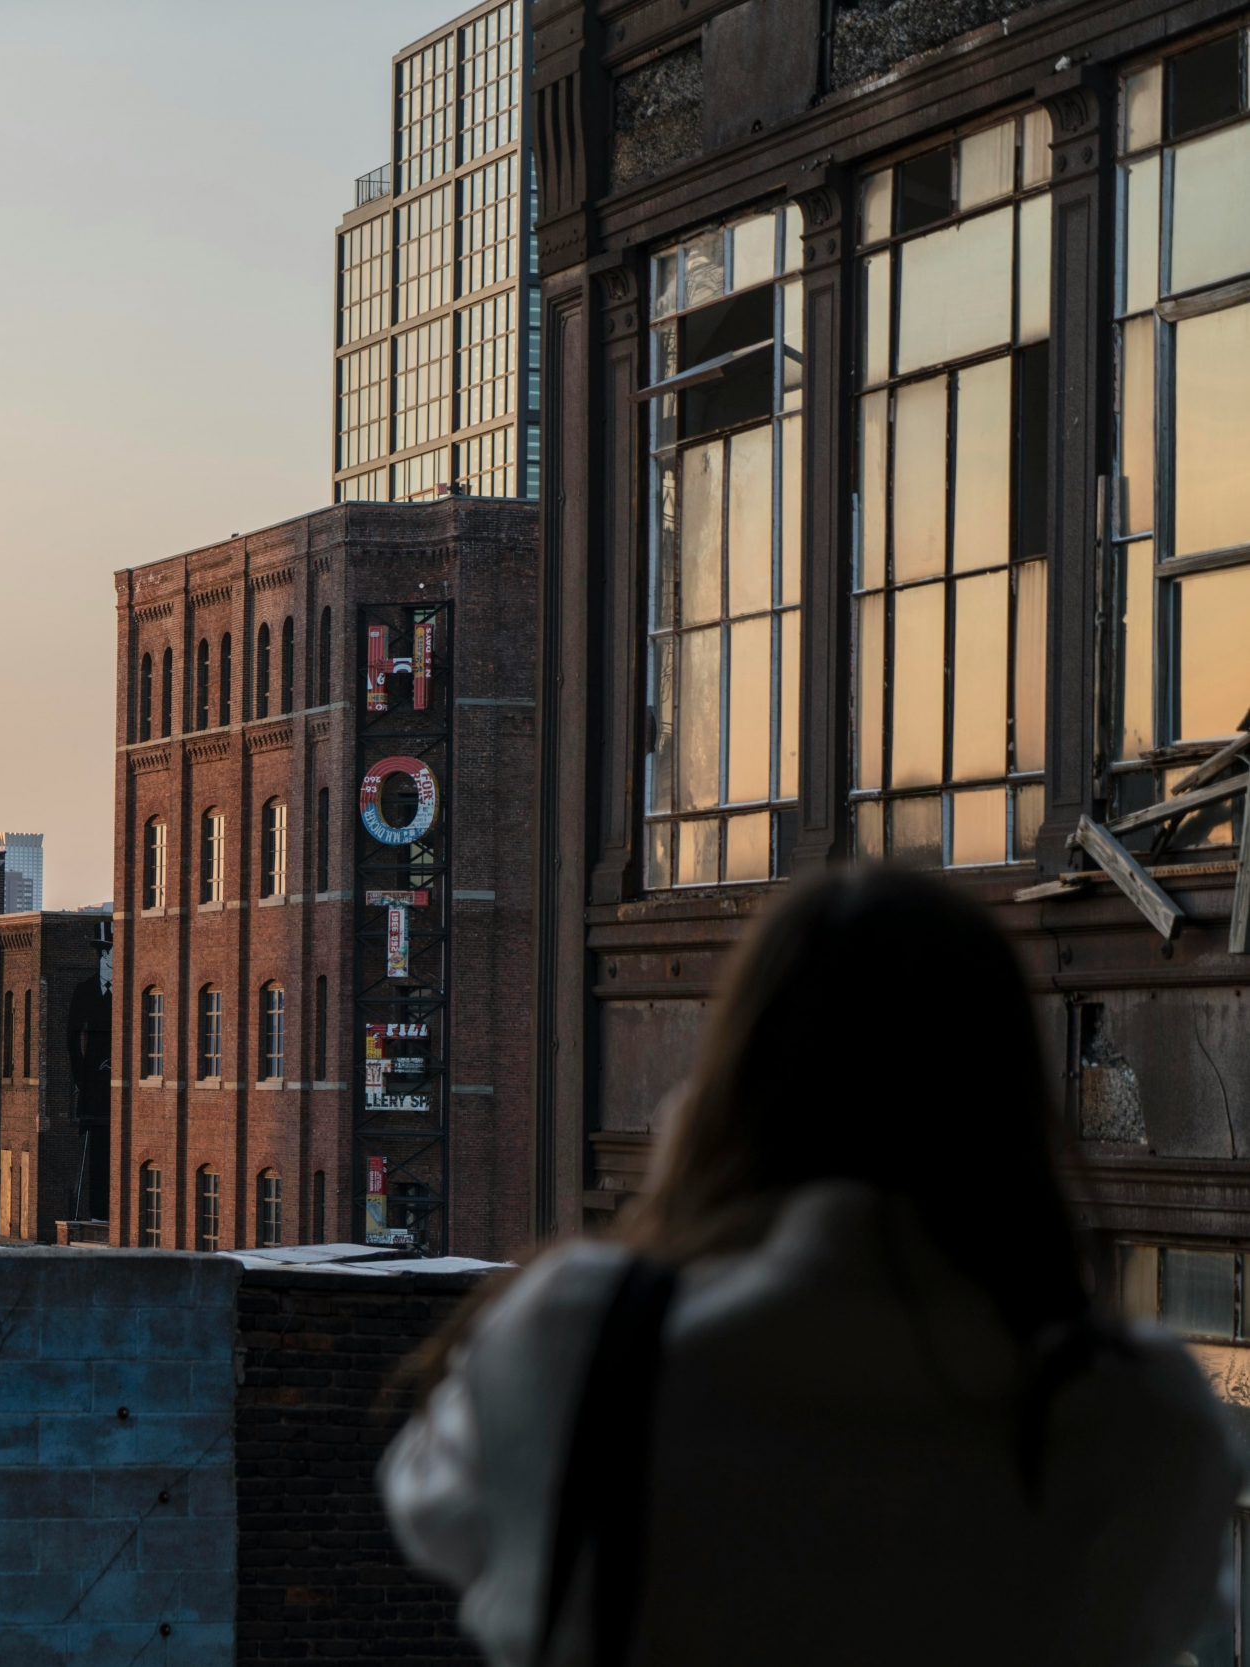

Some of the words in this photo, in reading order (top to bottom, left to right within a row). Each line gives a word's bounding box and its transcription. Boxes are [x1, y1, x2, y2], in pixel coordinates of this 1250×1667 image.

[421, 773, 434, 800] FOR
[364, 808, 386, 839] DICKER
[391, 912, 399, 932] 9361
